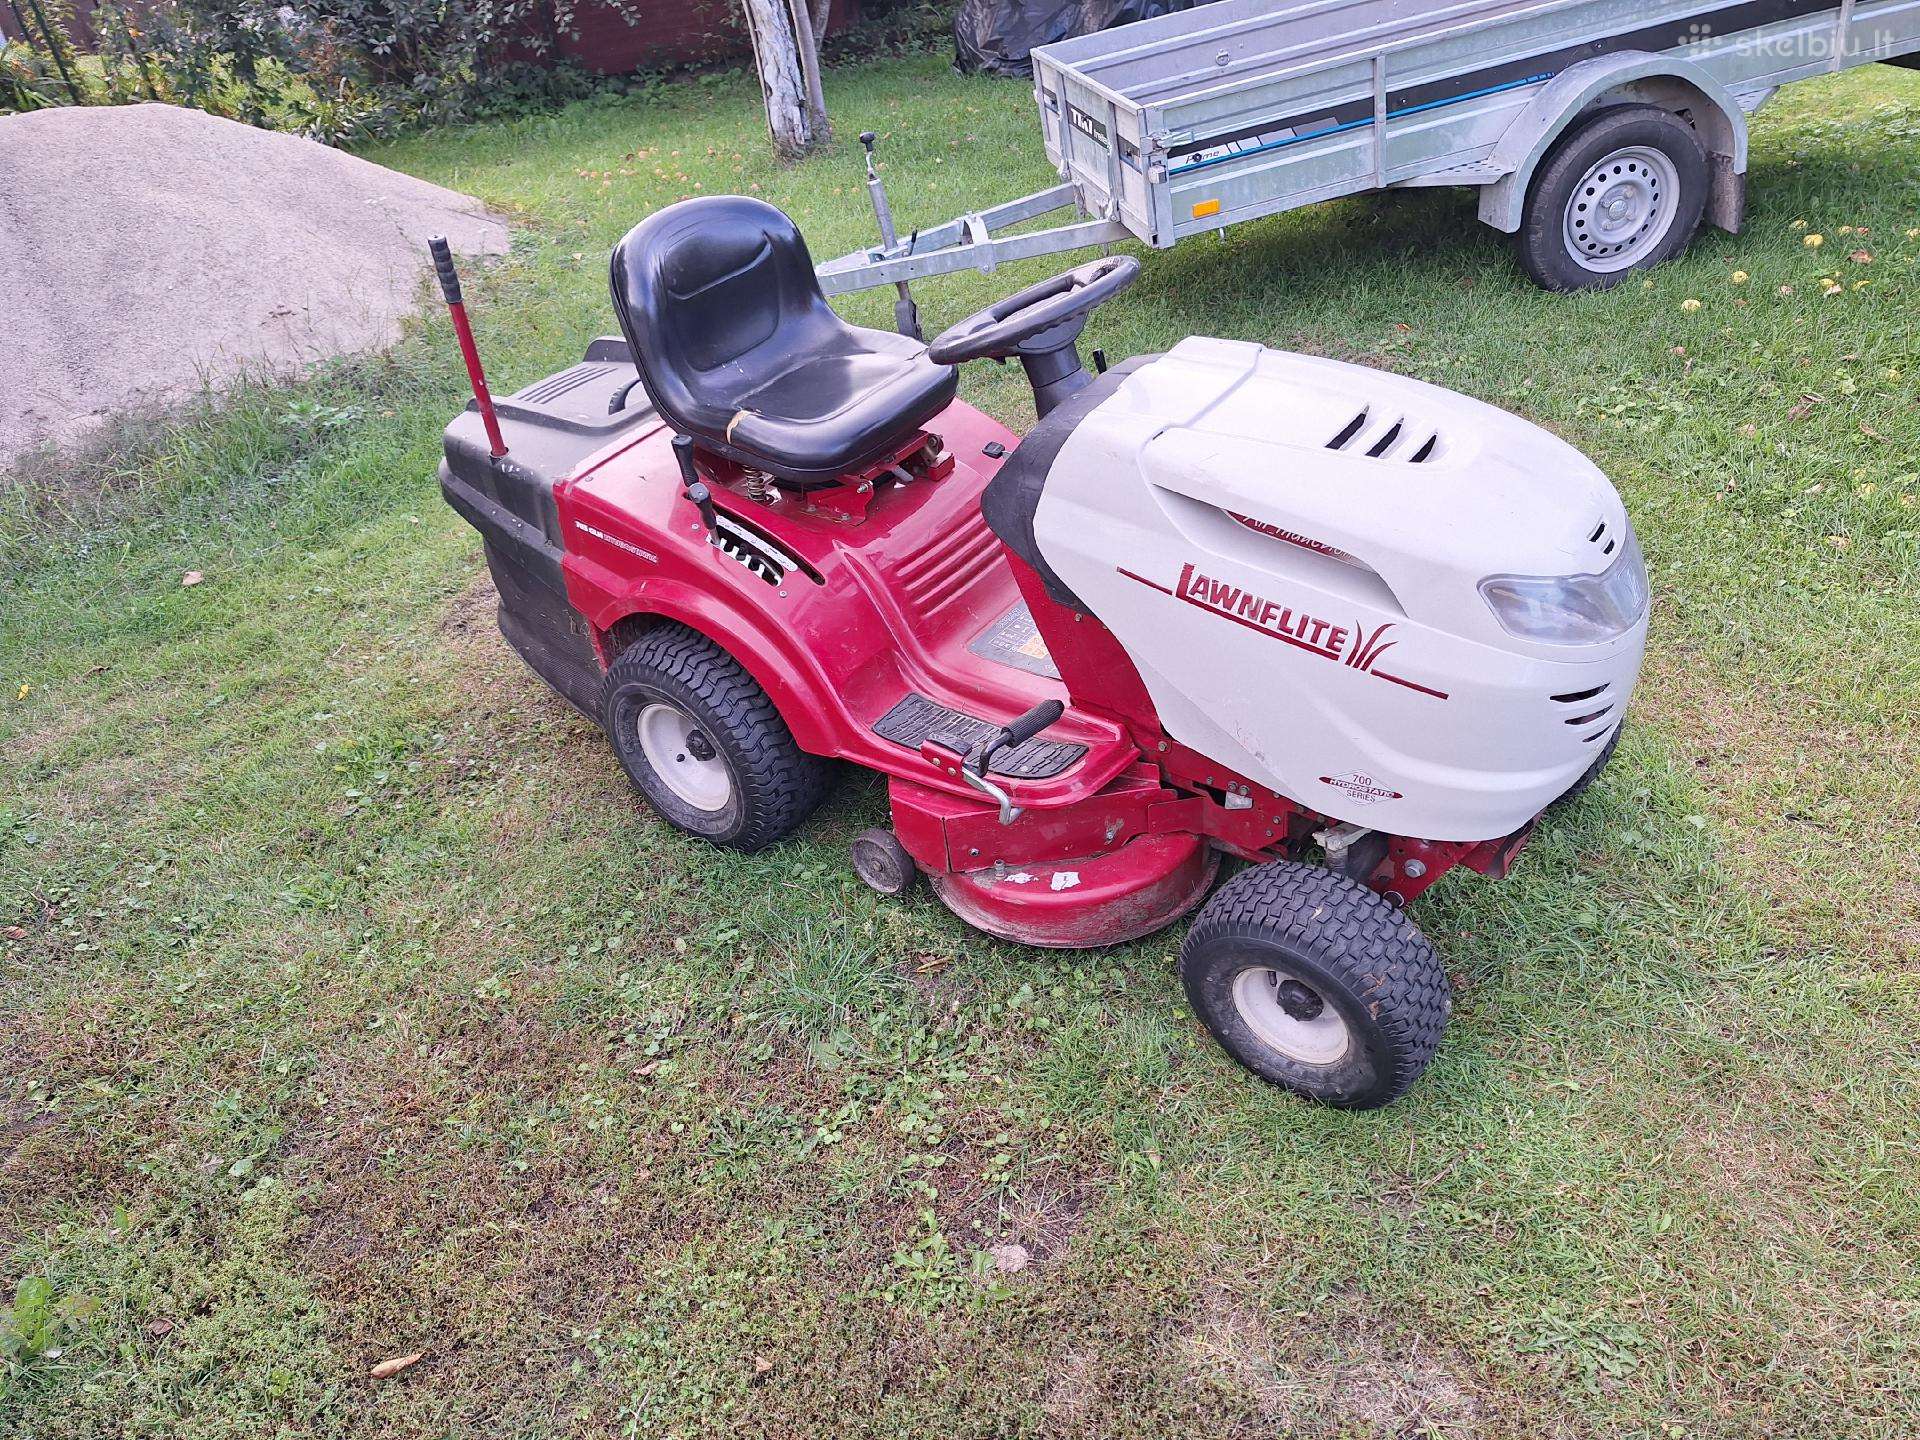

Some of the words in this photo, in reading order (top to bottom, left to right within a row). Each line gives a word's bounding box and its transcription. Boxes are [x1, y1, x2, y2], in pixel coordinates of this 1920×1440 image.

[1176, 562, 1349, 653] LAWNFLITE
[1352, 774, 1373, 786] 700
[1329, 779, 1396, 798] HYDROSTATIC
[1346, 789, 1376, 803] SERIES
